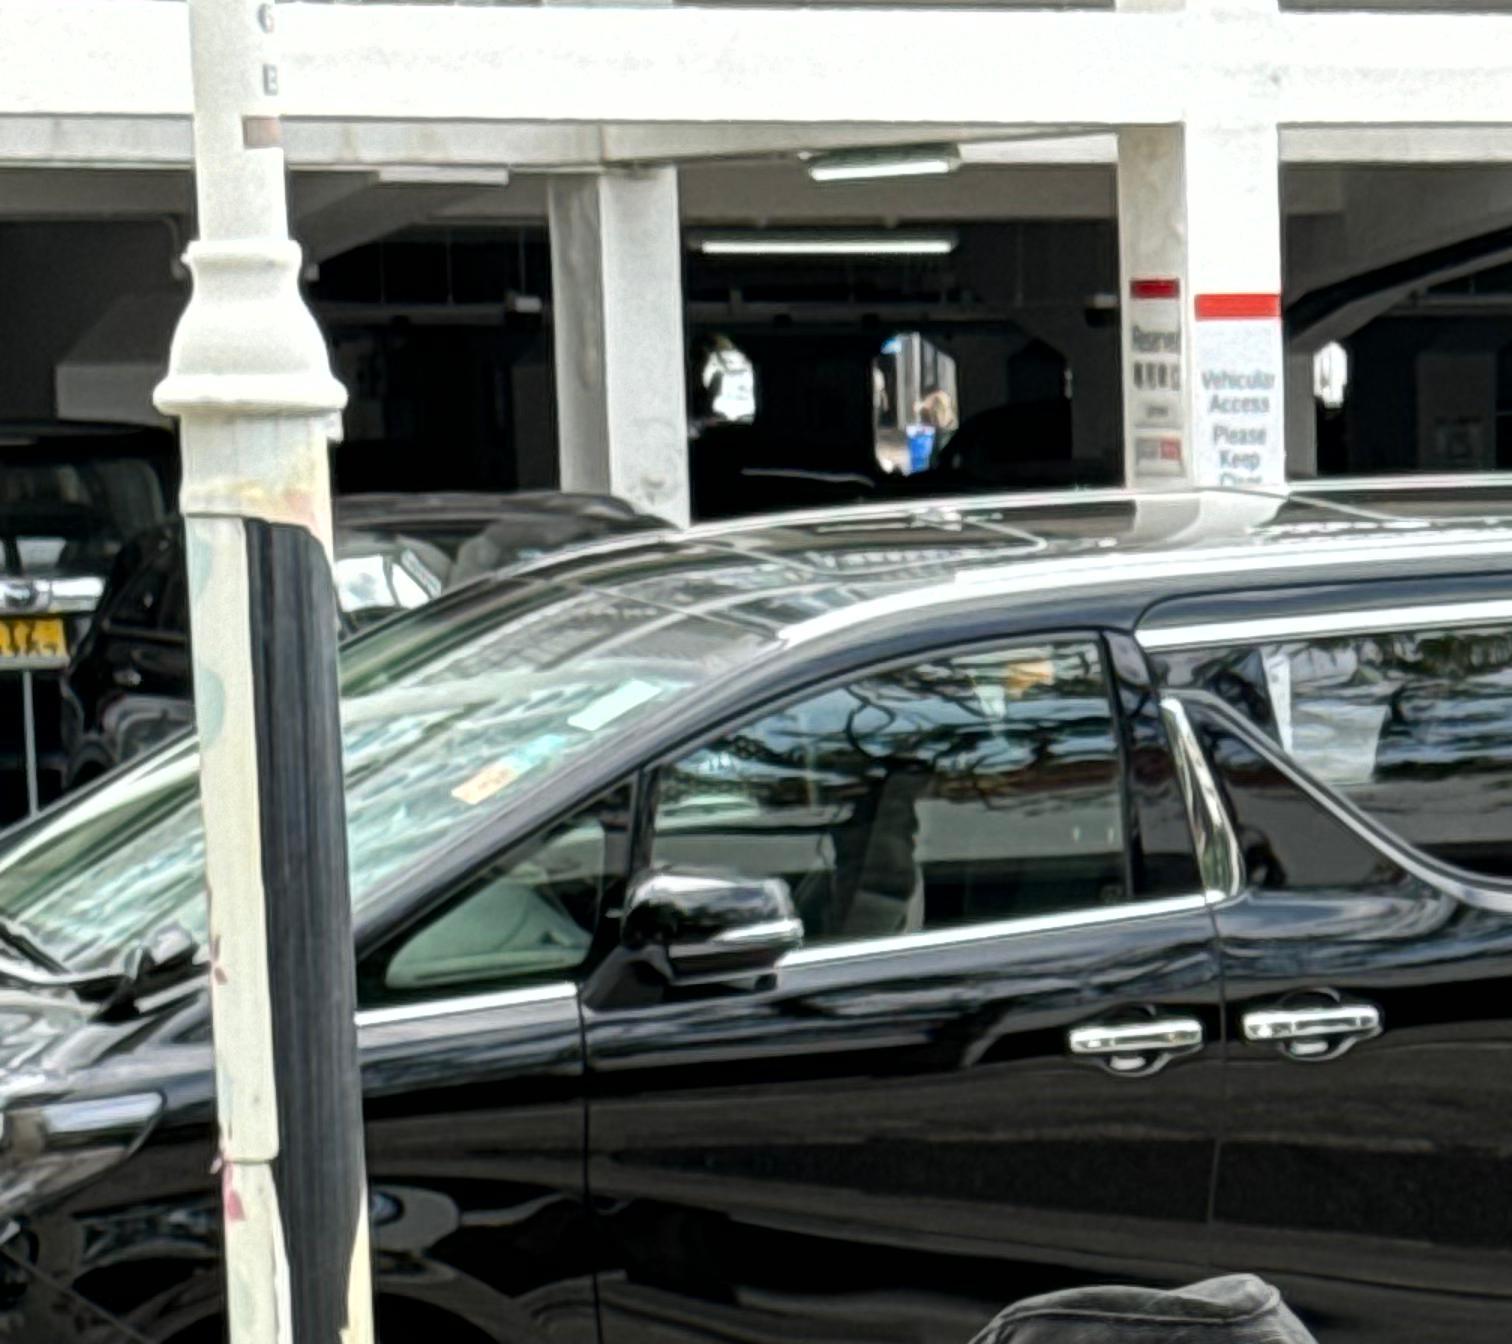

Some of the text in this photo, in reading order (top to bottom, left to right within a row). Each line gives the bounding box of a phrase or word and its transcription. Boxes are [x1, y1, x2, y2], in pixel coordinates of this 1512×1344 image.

[1201, 369, 1276, 390] Vehicular
[1208, 393, 1270, 413] Access
[1213, 424, 1267, 446] Please
[1219, 449, 1261, 471] Keep
